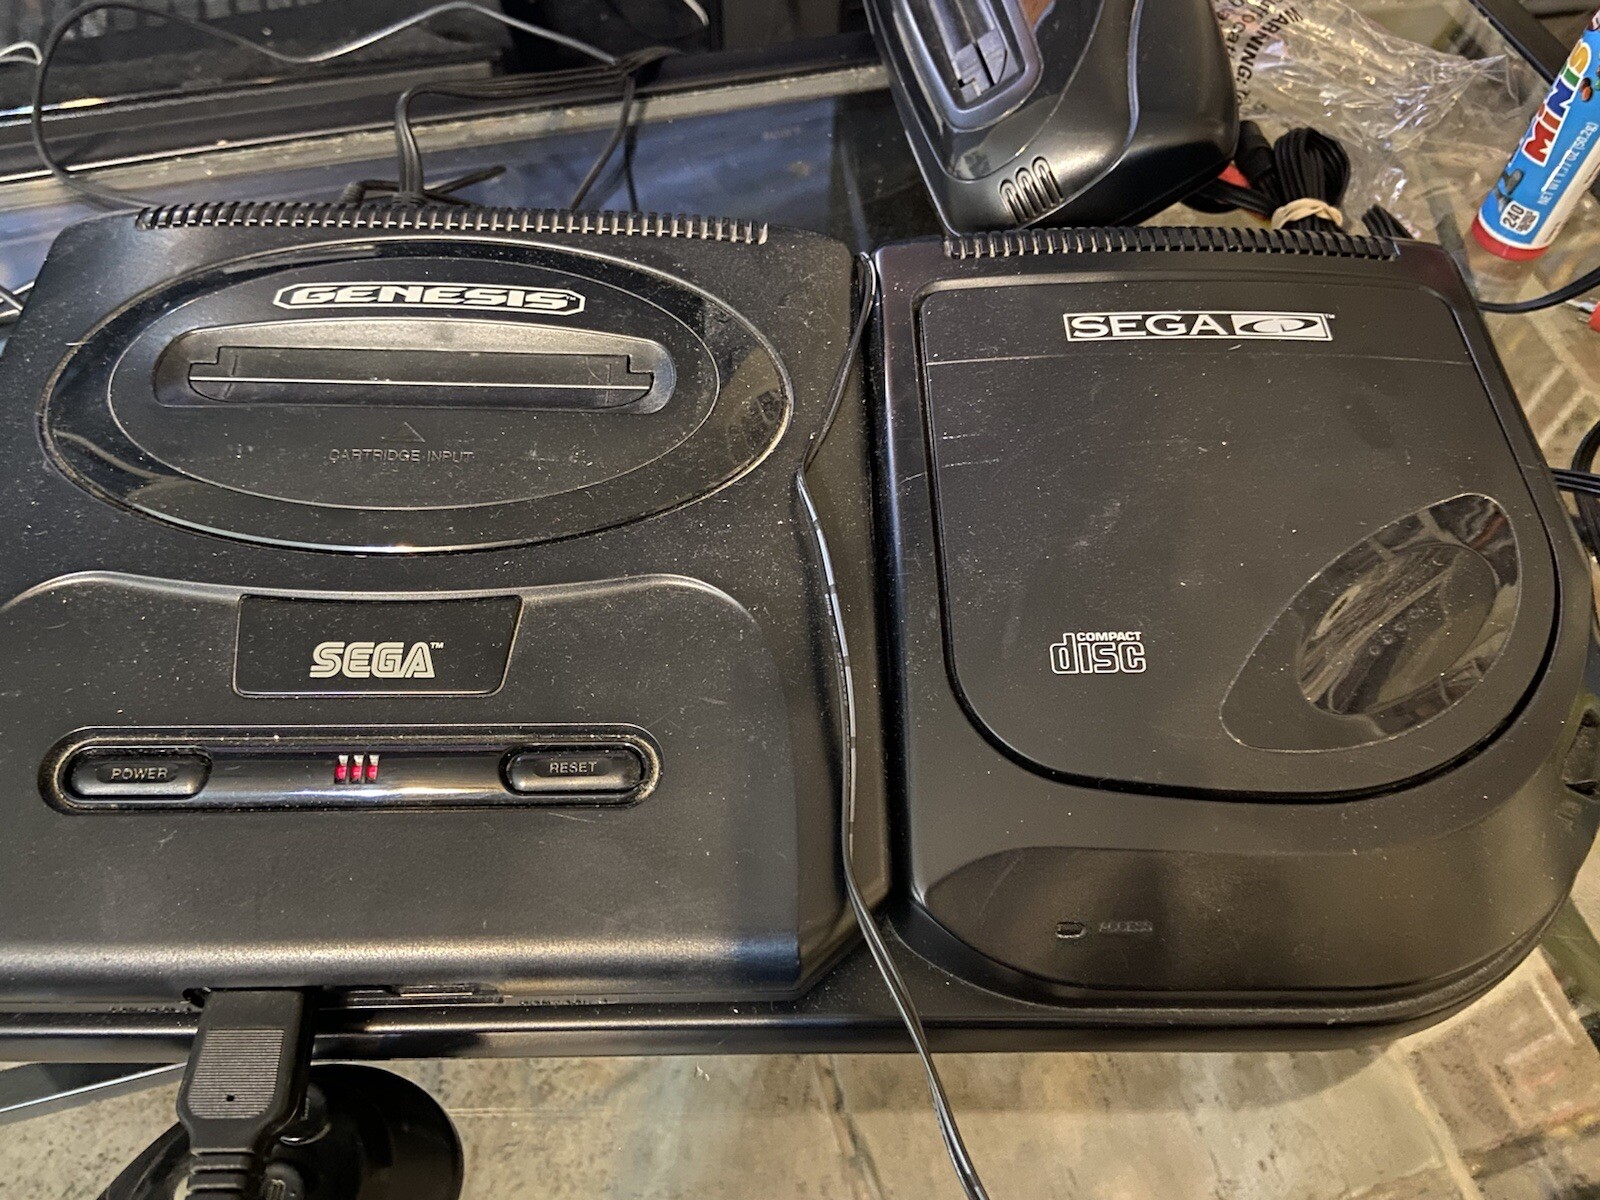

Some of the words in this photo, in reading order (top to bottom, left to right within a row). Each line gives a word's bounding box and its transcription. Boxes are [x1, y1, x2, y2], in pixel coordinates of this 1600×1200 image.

[1502, 203, 1525, 228] 240
[290, 285, 570, 309] GENESIS
[1070, 315, 1229, 338] SEGA
[329, 448, 420, 462] CARTRIDGE
[427, 450, 474, 463] INPUT
[1076, 631, 1141, 641] COMPACT
[309, 641, 435, 678] SEGA
[110, 767, 169, 780] POWER
[549, 761, 597, 774] RESET
